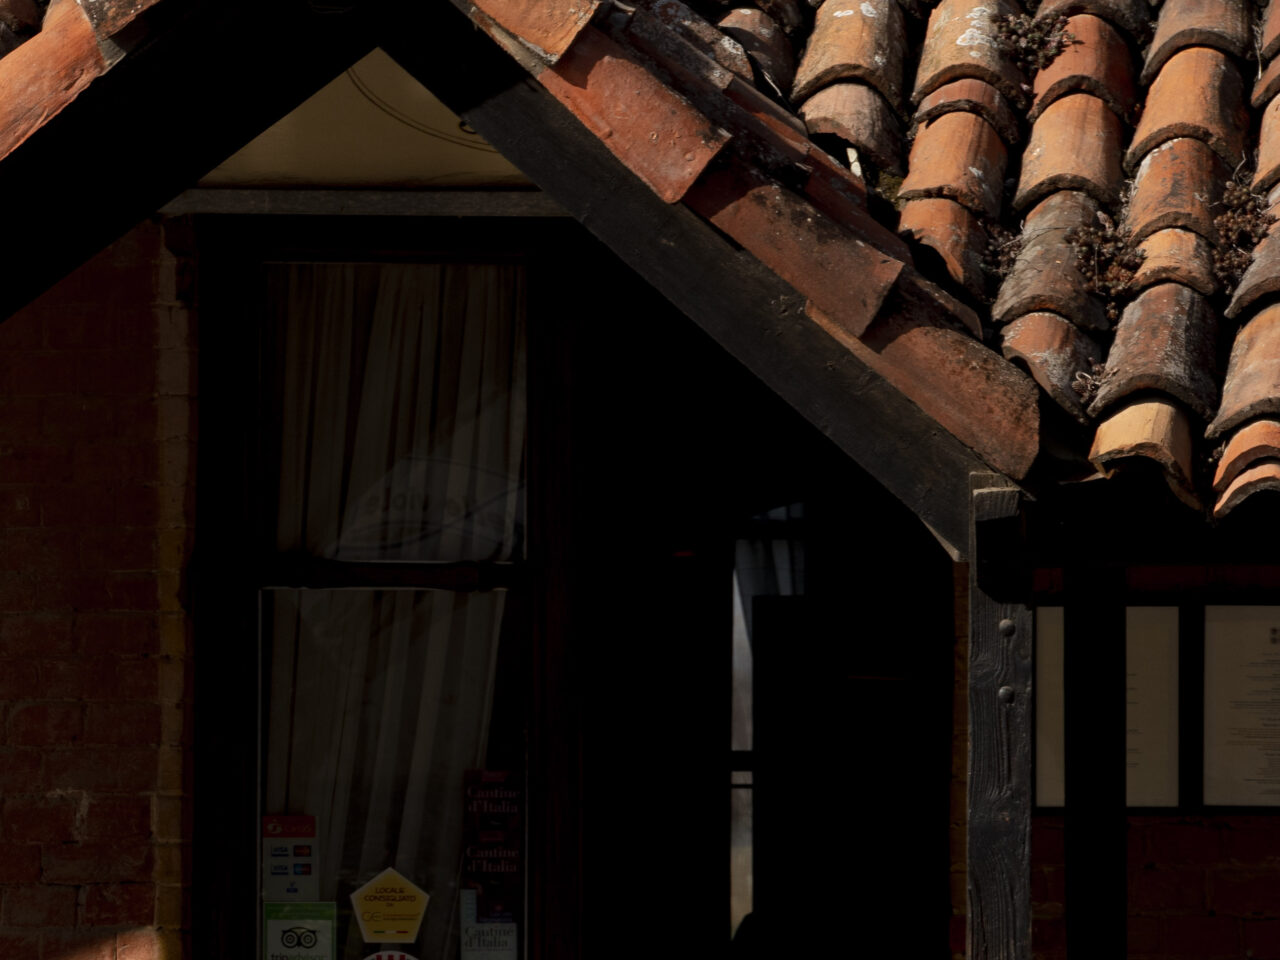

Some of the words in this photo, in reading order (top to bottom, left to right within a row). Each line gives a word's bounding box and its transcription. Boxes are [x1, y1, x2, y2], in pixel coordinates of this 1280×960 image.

[467, 785, 521, 798] Cantine
[468, 799, 518, 813] d'Italia
[465, 845, 520, 858] Cantine
[466, 859, 517, 873] d'Italia
